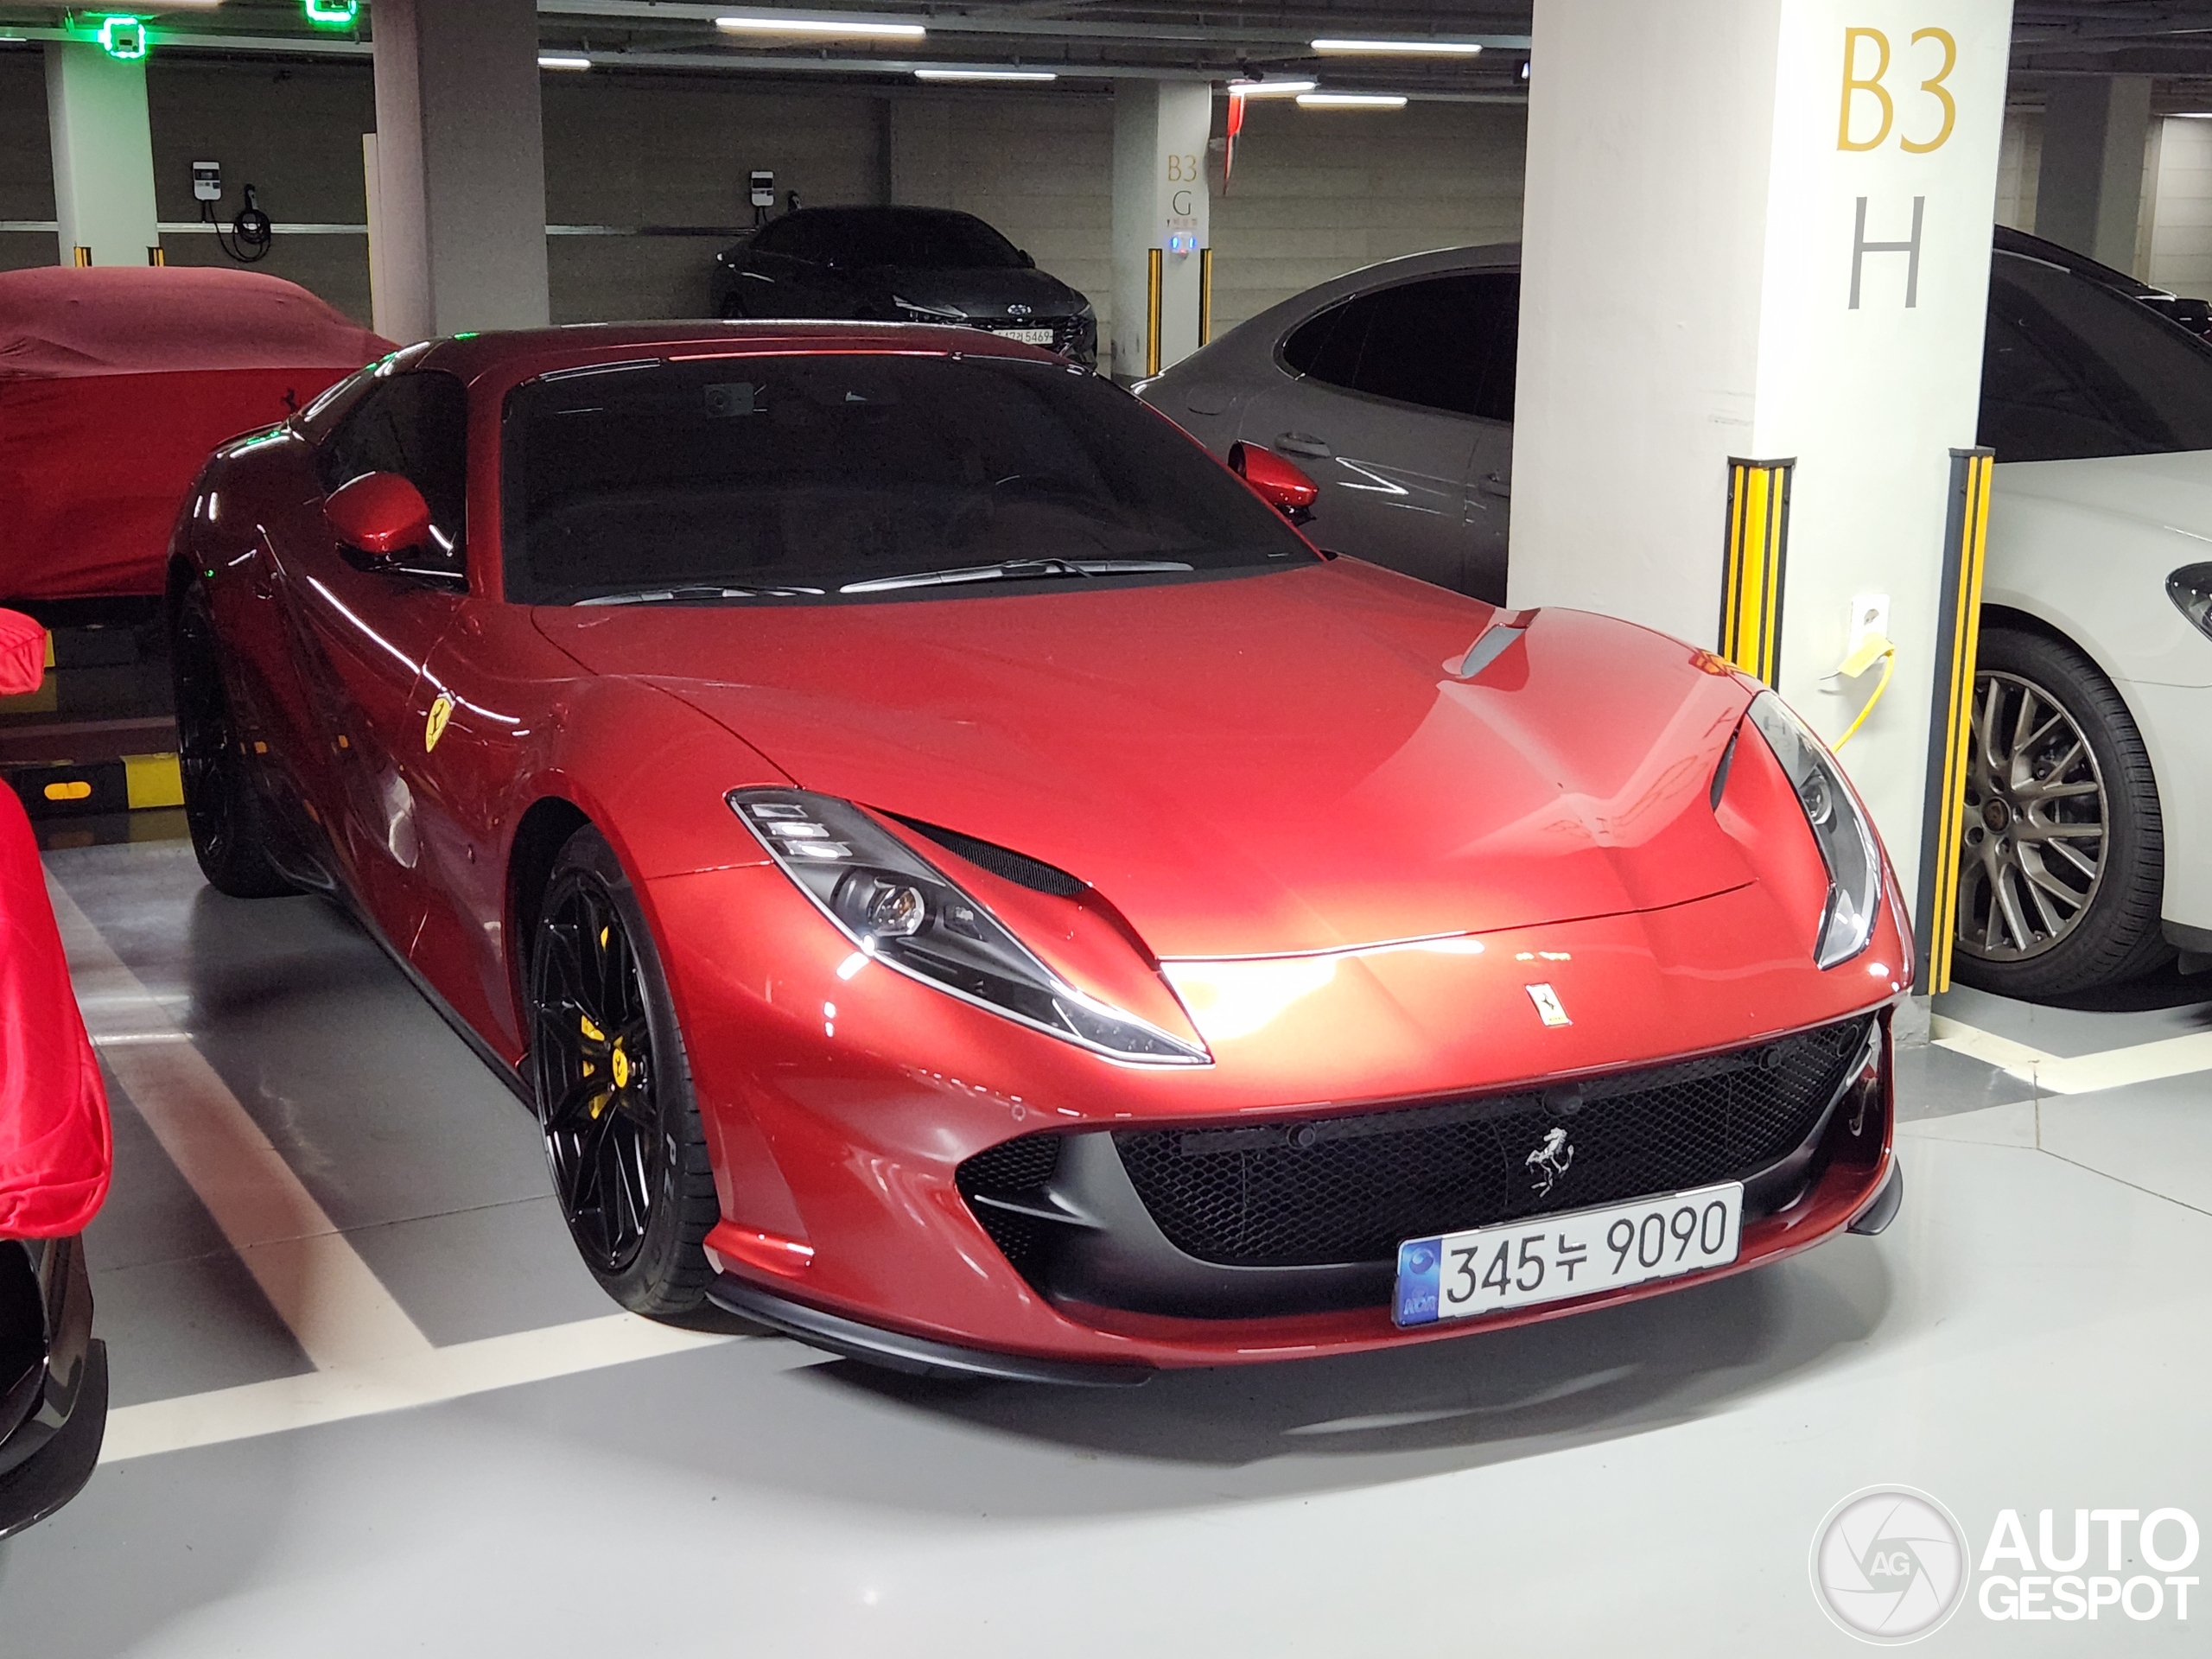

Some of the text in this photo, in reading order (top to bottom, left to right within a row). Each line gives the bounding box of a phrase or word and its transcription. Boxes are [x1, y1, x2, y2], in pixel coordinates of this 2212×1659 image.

[1837, 27, 1956, 154] B3
[1168, 155, 1197, 181] B3
[1172, 190, 1192, 216] G
[1848, 195, 1925, 310] H
[1446, 1200, 1727, 1303] 345누 9090
